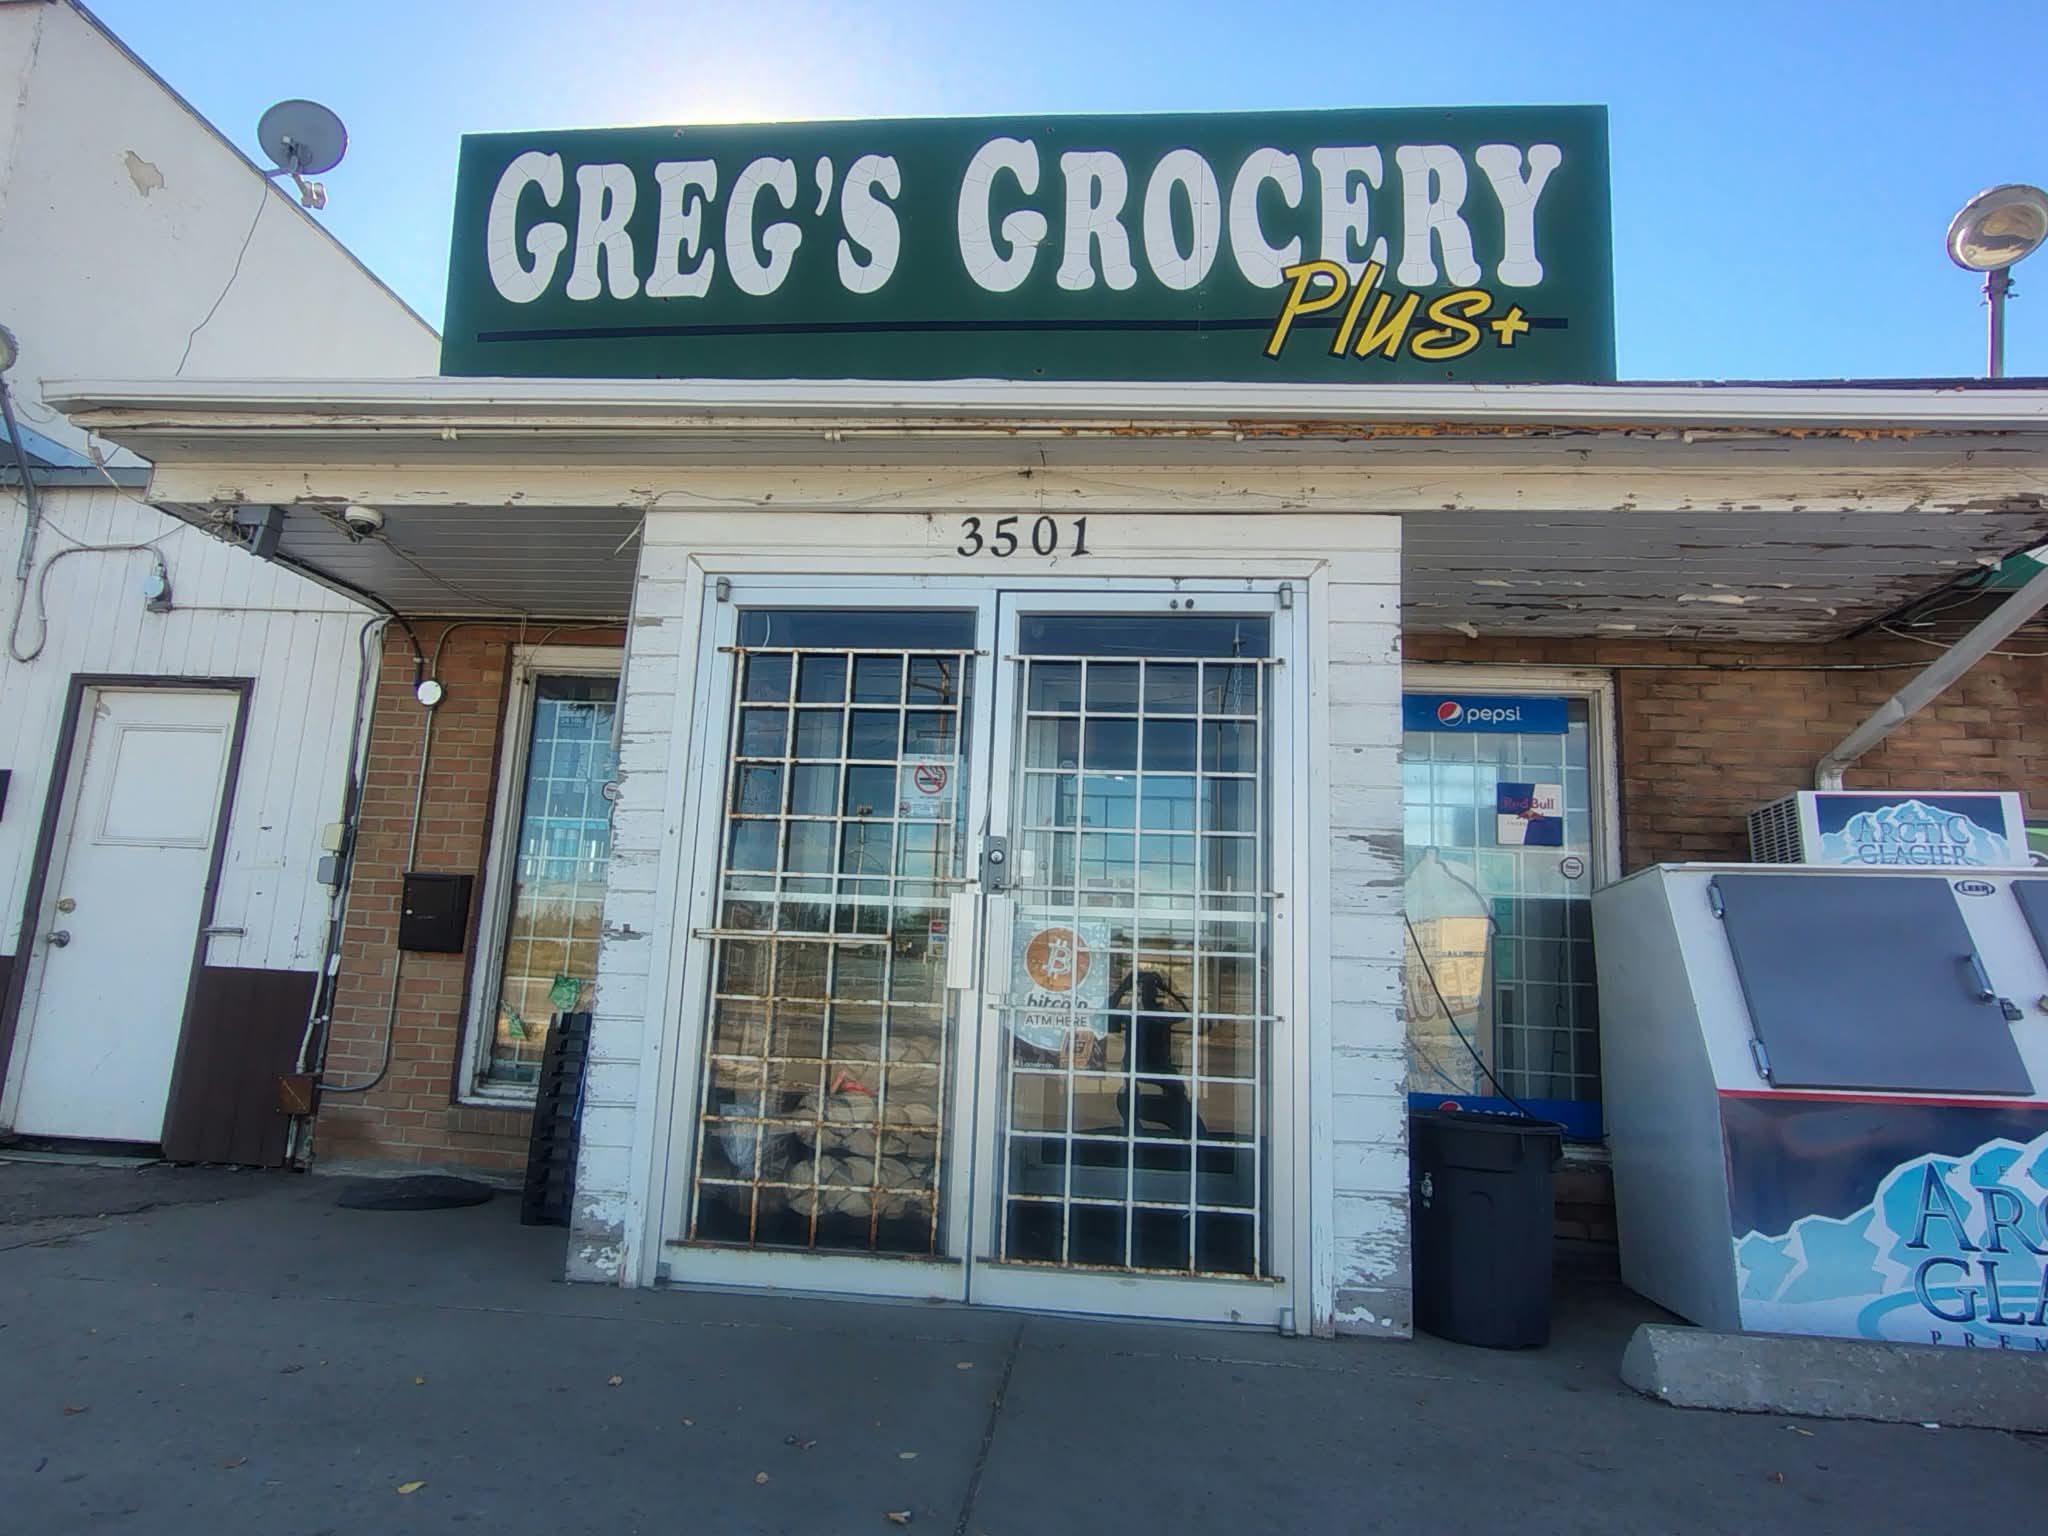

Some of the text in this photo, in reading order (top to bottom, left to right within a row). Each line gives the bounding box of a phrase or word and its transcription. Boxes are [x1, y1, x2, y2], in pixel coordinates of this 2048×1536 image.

[487, 136, 1563, 303] GREG'S GROCERY
[956, 515, 1093, 557] 3501
[1467, 706, 1521, 725] pepsi
[1531, 797, 1555, 810] Bull
[1856, 814, 1971, 845] ARCTIC
[1858, 844, 1972, 866] GLACIER
[1026, 992, 1089, 1010] bitcoin
[1025, 1014, 1087, 1027] ATM HERE
[1904, 1161, 2048, 1256] AR
